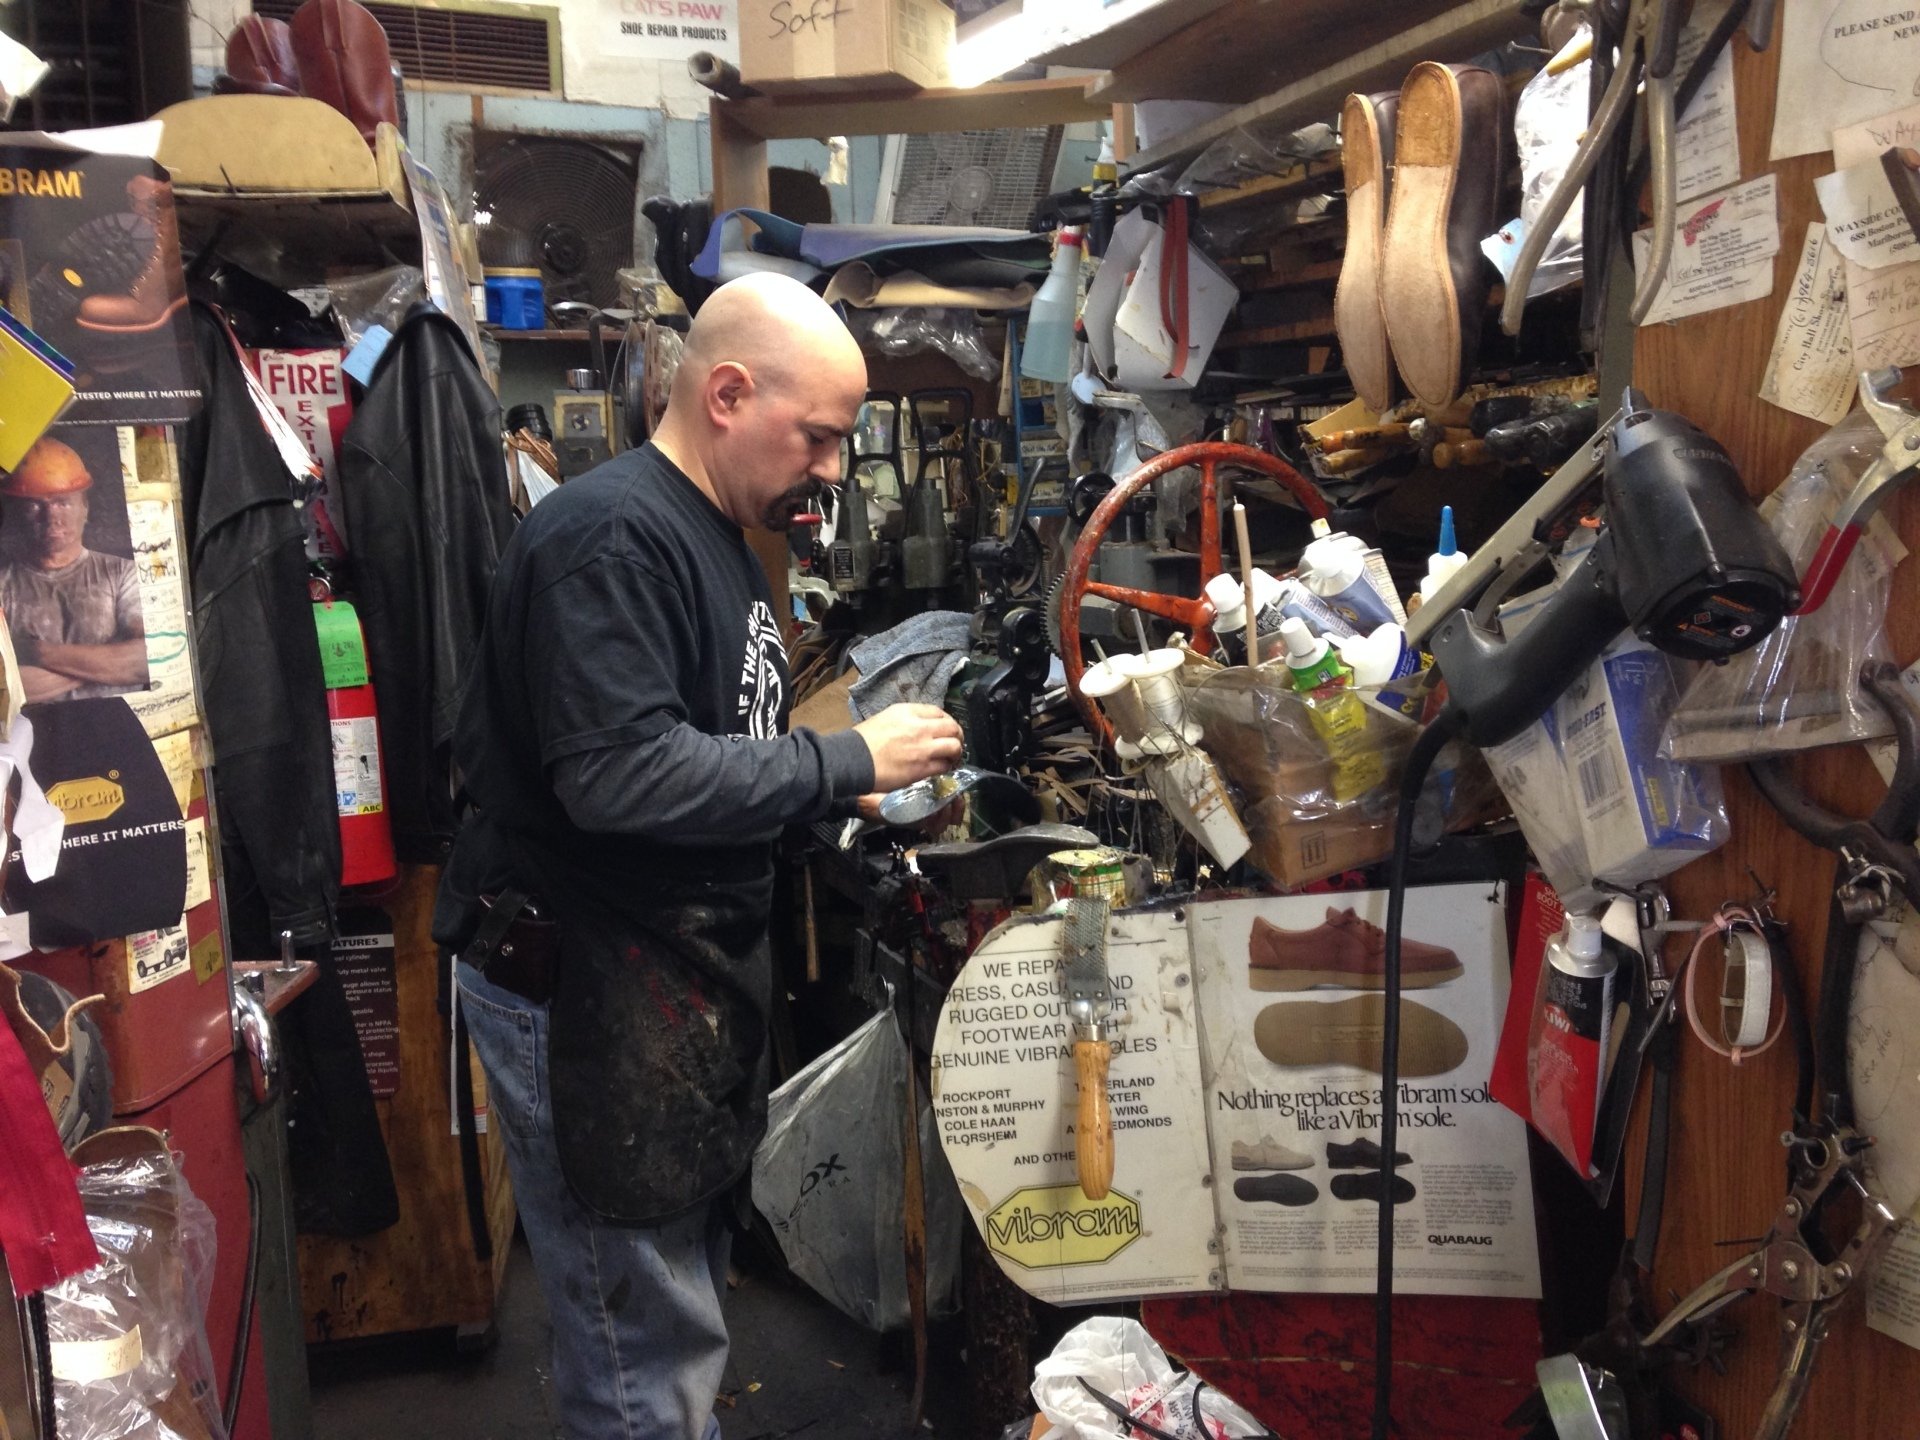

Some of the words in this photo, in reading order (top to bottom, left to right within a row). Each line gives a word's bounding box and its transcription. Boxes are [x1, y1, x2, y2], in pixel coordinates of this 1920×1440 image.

[678, 2, 723, 21] PAW
[768, 0, 853, 39] Soft
[620, 21, 643, 35] SHOE
[647, 22, 678, 38] REPAIR
[682, 25, 727, 41] PRODUCTS
[1834, 18, 1880, 38] PLEASE
[1882, 10, 1915, 27] SEND
[0, 168, 82, 199] BRAM
[1834, 211, 1883, 234] WAYSIDE
[1811, 304, 1825, 327] Shoe
[1806, 329, 1817, 348] Hall
[1792, 352, 1811, 371] City
[268, 363, 338, 396] FIRE
[113, 390, 147, 400] WHERE
[148, 390, 159, 399] IT
[160, 389, 203, 399] MATTERS
[740, 640, 758, 686] THE
[737, 693, 751, 716] IF
[362, 803, 382, 813] ABC
[62, 833, 100, 849] HERE
[103, 830, 119, 842] IT
[122, 819, 186, 838] MATTERS
[333, 937, 379, 947] ATURES
[345, 954, 370, 962] cylinder
[983, 962, 1012, 979] WE
[1018, 959, 1065, 977] REPA
[1011, 980, 1067, 1000] CASU
[949, 1005, 1028, 1025] RUGGED
[1543, 1005, 1571, 1033] KIWI
[962, 1023, 1067, 1046] FOOTWEAR
[931, 1048, 1011, 1070] GENUINE
[1110, 1037, 1158, 1055] OLES
[942, 1088, 1012, 1103] ROCKPORT
[1108, 1091, 1141, 1104] XTER
[1218, 1090, 1295, 1117] Nothing
[1295, 1085, 1370, 1114] replaces
[1372, 1090, 1382, 1105] a
[936, 1106, 978, 1118] NSTON
[981, 1105, 990, 1115] &
[993, 1099, 1046, 1114] MURPHY
[1115, 1104, 1149, 1116] WING
[1296, 1109, 1325, 1131] like
[1328, 1115, 1340, 1131] a
[1340, 1109, 1411, 1131] Vibrm
[1414, 1106, 1457, 1128] sole.
[945, 1118, 979, 1131] COLE
[981, 1116, 1016, 1129] HAAN
[1112, 1117, 1173, 1131] EDMONDS
[946, 1129, 1017, 1145] FLORSHEIM
[1013, 1154, 1039, 1166] AND
[1042, 1151, 1076, 1165] OTHE
[988, 1205, 1139, 1246] vibram
[1427, 1234, 1493, 1246] QUABAUG
